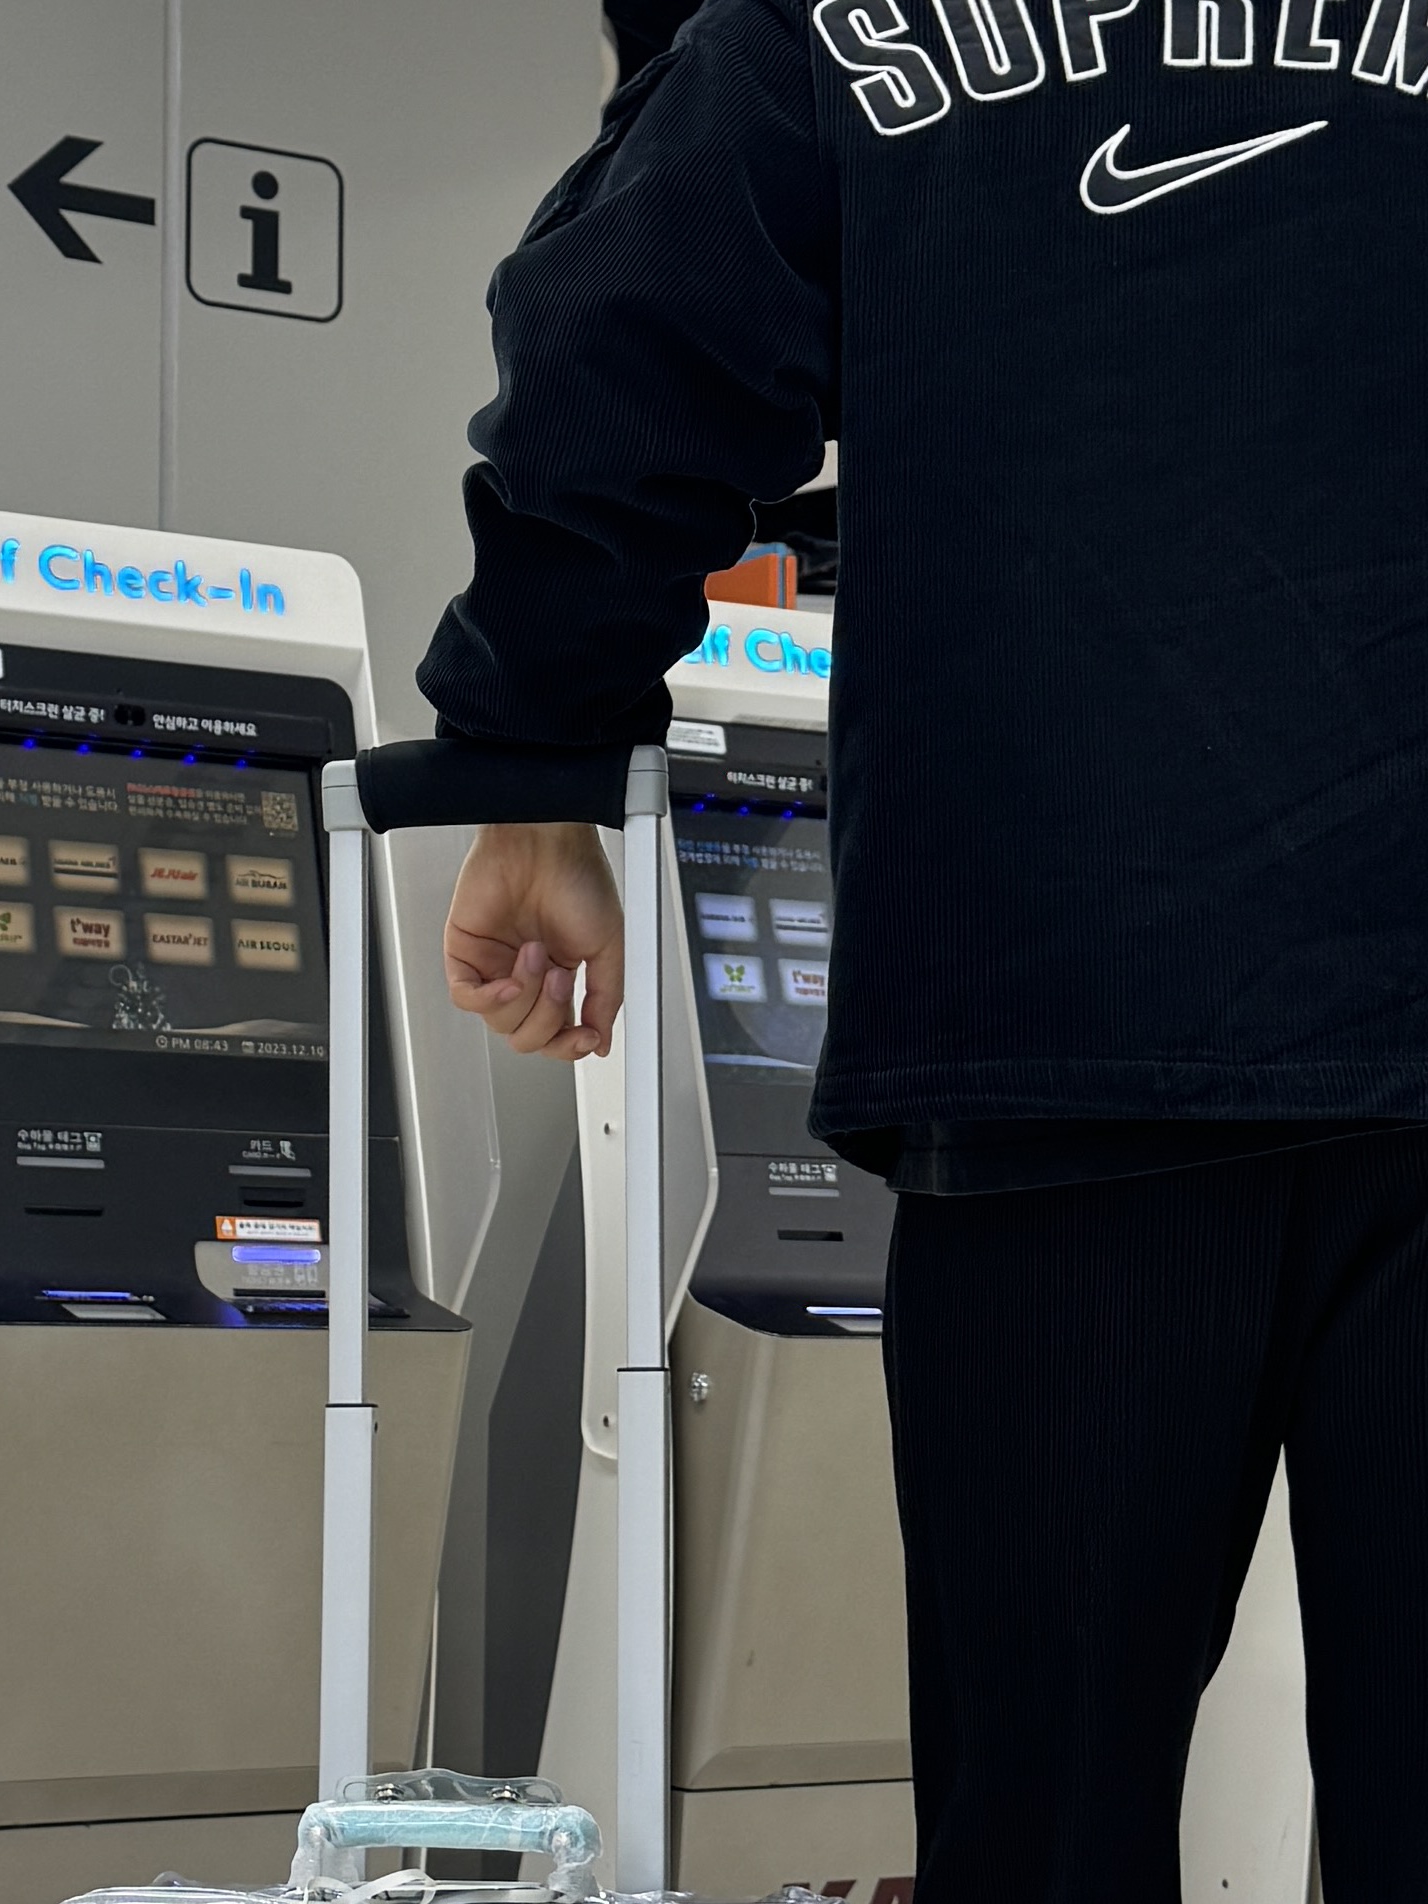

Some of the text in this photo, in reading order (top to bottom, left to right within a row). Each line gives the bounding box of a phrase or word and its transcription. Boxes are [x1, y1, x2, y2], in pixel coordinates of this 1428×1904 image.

[37, 543, 286, 616] Check-In
[0, 698, 59, 719] 터치스크린
[62, 704, 86, 722] 살균
[152, 713, 198, 732] 안심하고
[200, 719, 258, 737] 이용하세요
[171, 1037, 190, 1049] PM
